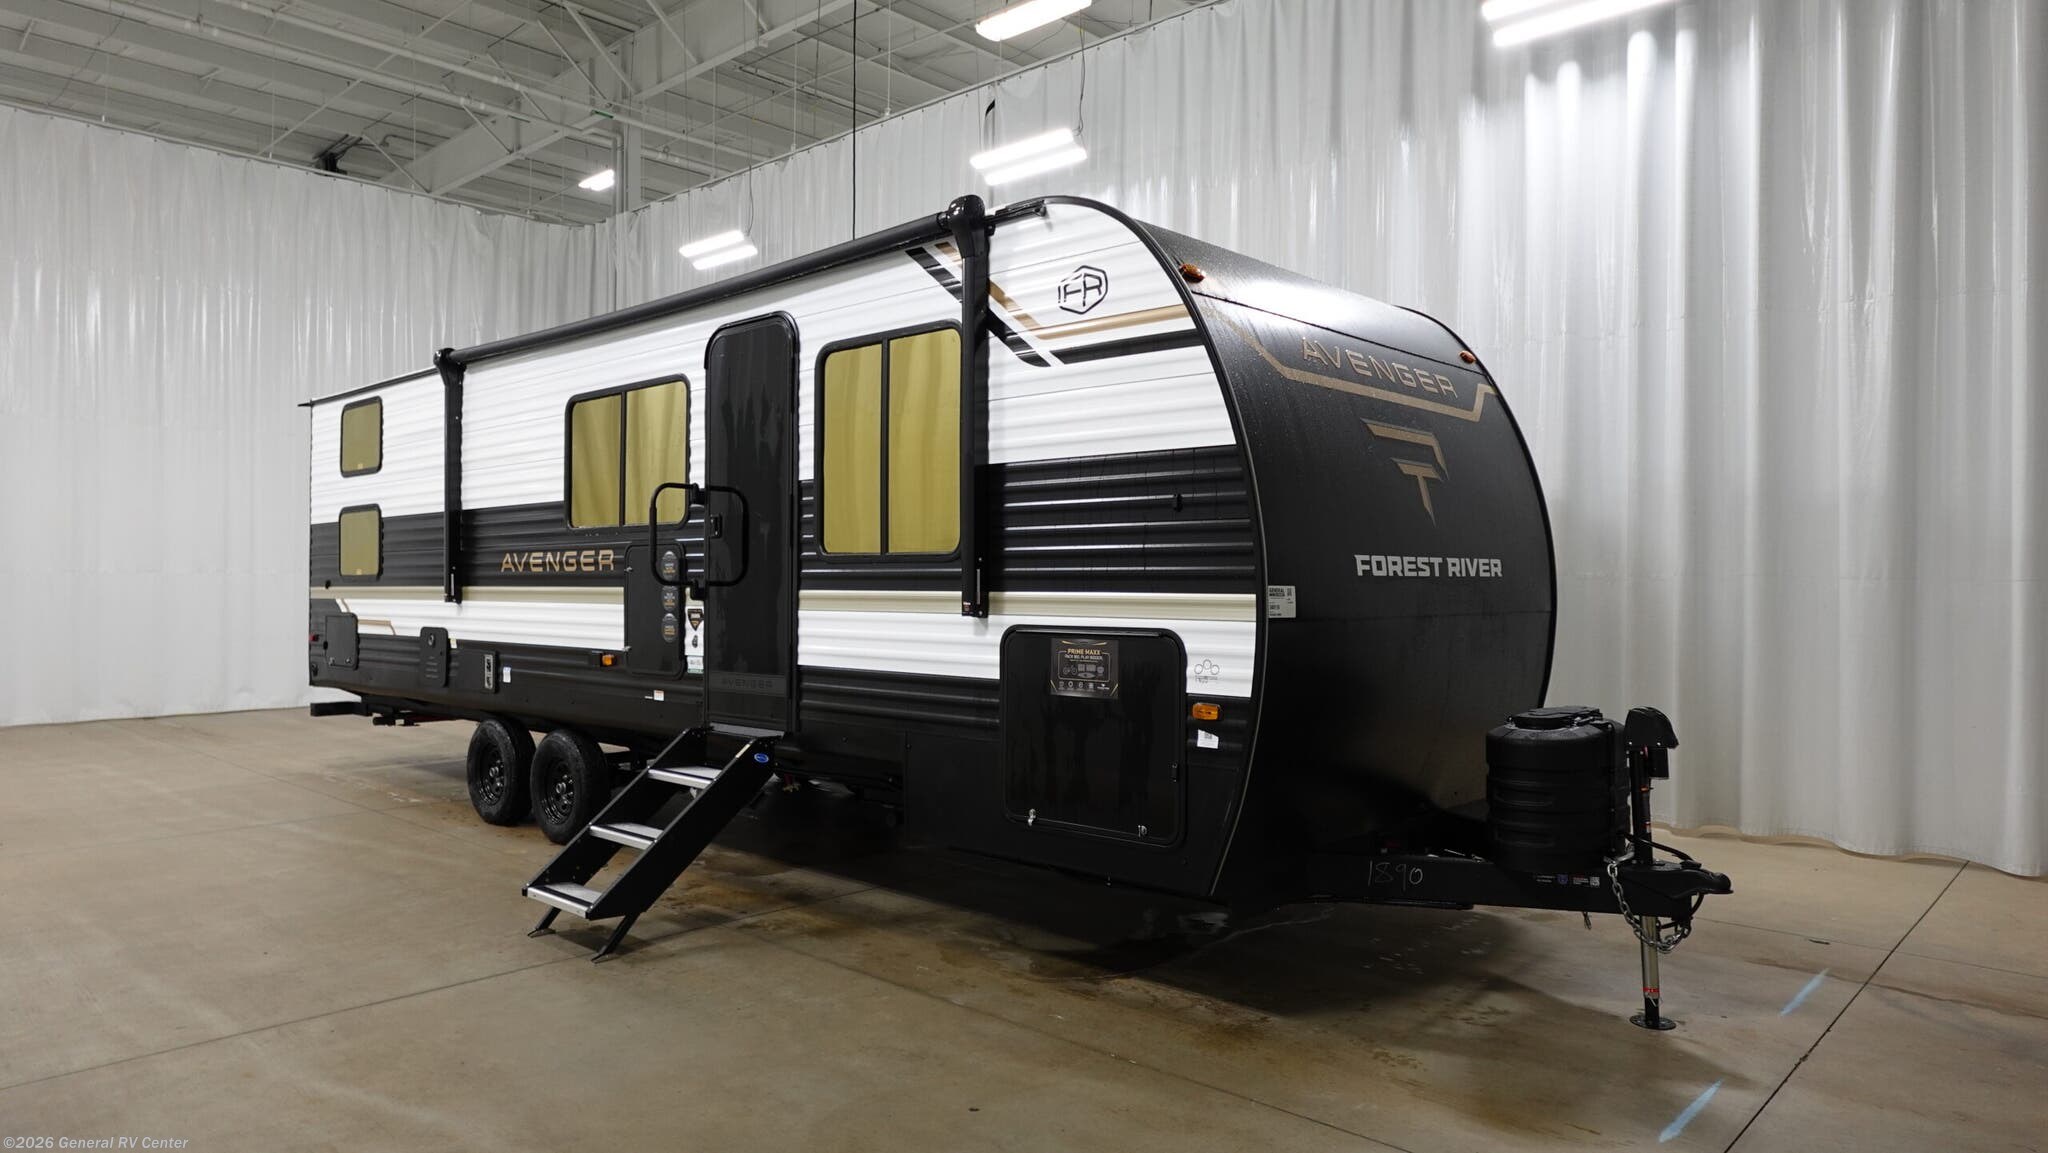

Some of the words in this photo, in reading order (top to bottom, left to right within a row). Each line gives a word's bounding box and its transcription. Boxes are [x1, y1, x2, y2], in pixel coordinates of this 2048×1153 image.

[1302, 337, 1458, 399] AVENGER
[500, 549, 615, 573] AVENGER
[1354, 554, 1443, 577] FOREST
[1446, 557, 1503, 577] RIVER
[1367, 859, 1424, 892] 1890
